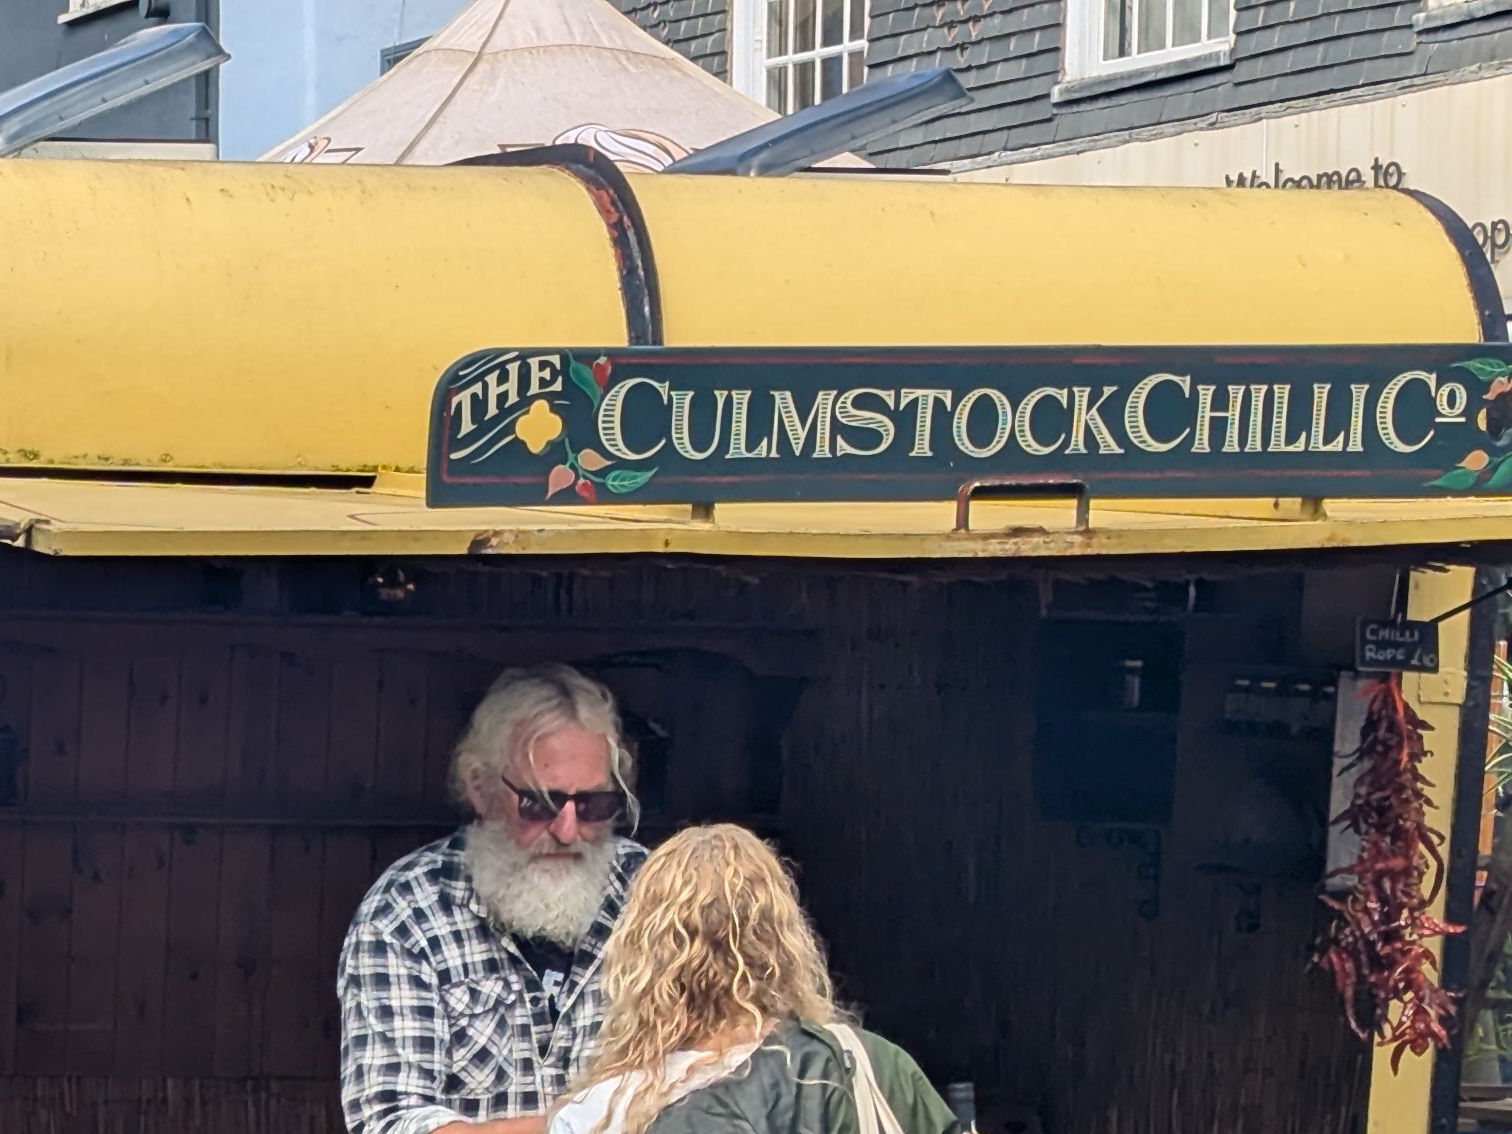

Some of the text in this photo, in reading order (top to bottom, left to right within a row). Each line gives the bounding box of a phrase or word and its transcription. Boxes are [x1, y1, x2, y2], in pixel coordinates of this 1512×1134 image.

[1371, 157, 1403, 189] to
[451, 354, 564, 440] THE
[597, 377, 1125, 461] CULMSTOCK
[1124, 373, 1371, 453] CHILLI
[1365, 624, 1419, 642] CHILLI
[1364, 644, 1406, 661] ROPE
